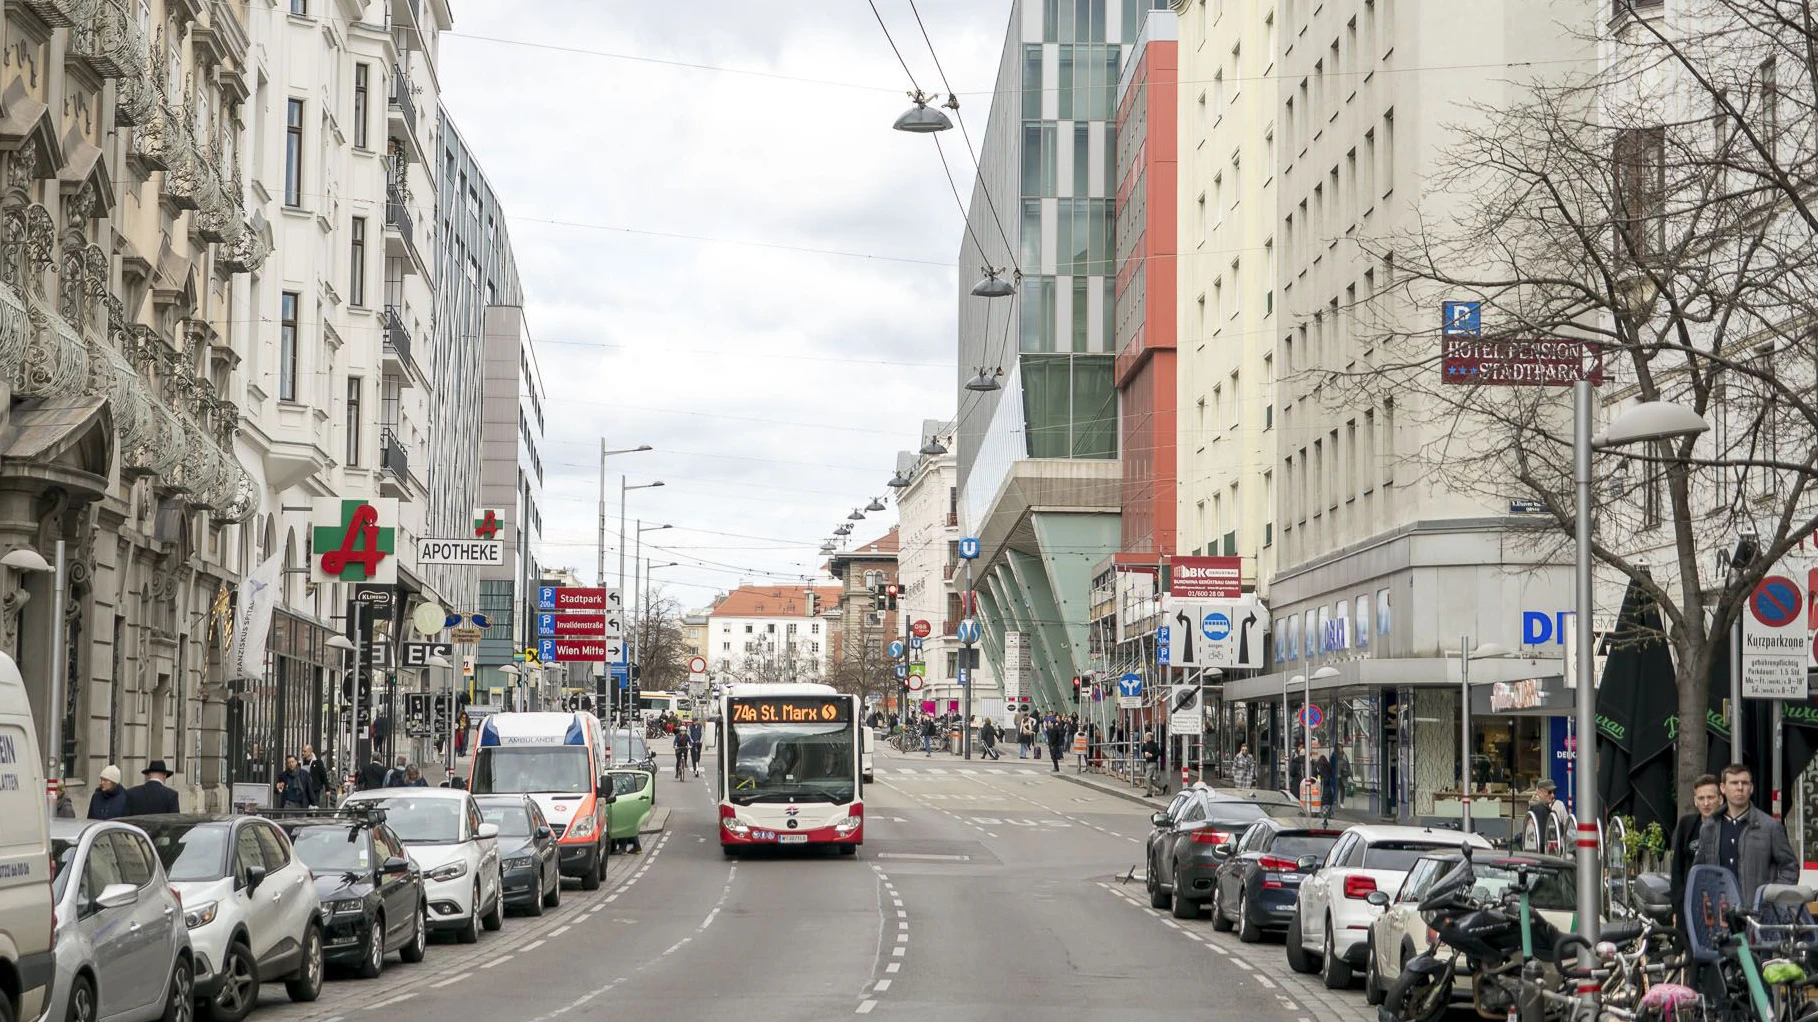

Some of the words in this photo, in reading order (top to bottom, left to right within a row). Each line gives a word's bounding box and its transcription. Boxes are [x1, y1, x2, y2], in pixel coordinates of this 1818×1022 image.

[1479, 362, 1580, 382] STADTPARK
[422, 543, 498, 561] APOTHEKE
[560, 594, 602, 604] Stadtpark
[243, 600, 255, 626] SPITAL
[557, 621, 604, 629] Invalidenstraße
[556, 645, 580, 655] Wien
[582, 645, 605, 655] Mitte
[1747, 633, 1804, 650] Kurzparkzone
[733, 704, 757, 721] 74A
[761, 704, 779, 721] St.
[783, 704, 818, 721] Marx
[1594, 713, 1626, 738] uran
[508, 736, 555, 744] AMBULANCE
